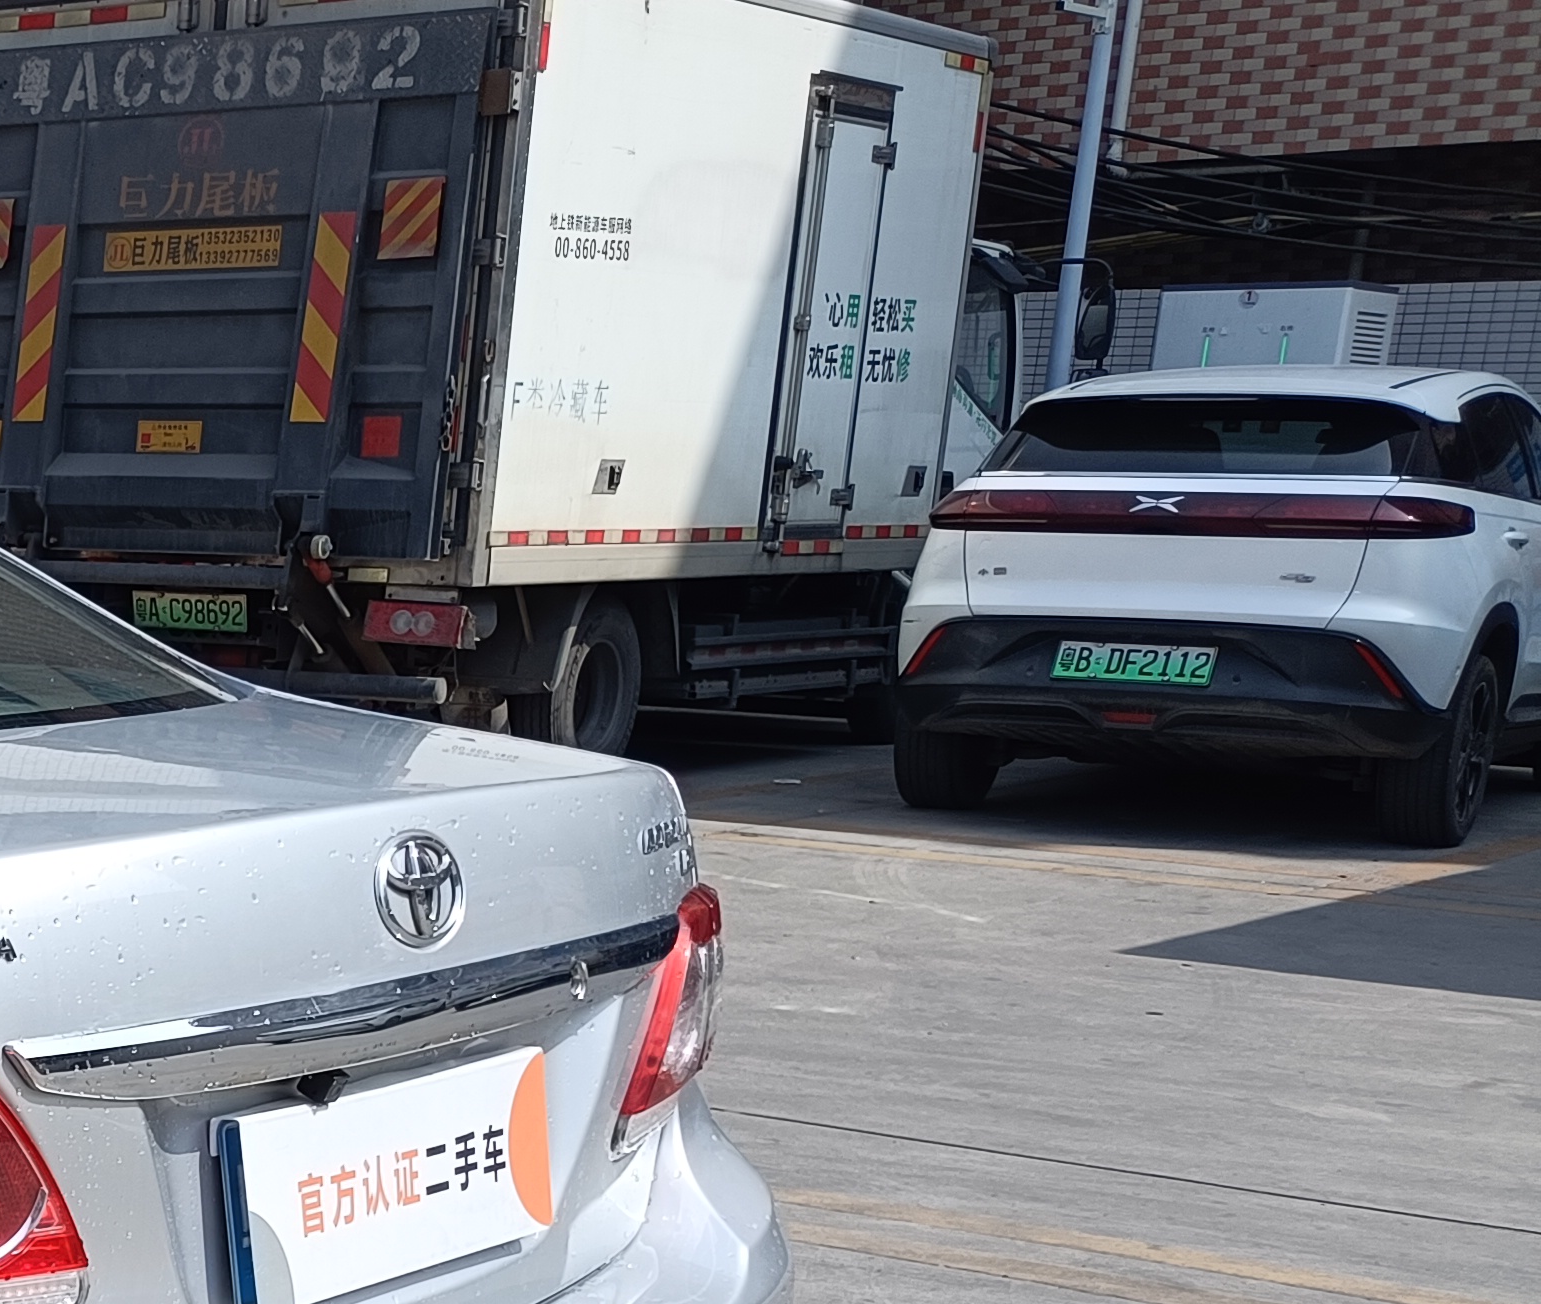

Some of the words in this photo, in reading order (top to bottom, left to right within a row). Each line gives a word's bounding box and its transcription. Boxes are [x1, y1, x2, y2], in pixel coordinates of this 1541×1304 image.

[119, 168, 280, 219] 巨力尾板
[131, 234, 199, 267] 巨力尾板
[200, 228, 280, 245] 13532352130
[198, 248, 278, 266] 13392777569
[871, 297, 917, 333] 轻松买
[807, 343, 855, 379] 欢乐租
[865, 347, 911, 383] 无忧修
[297, 1124, 507, 1237] 官方认证二手车
